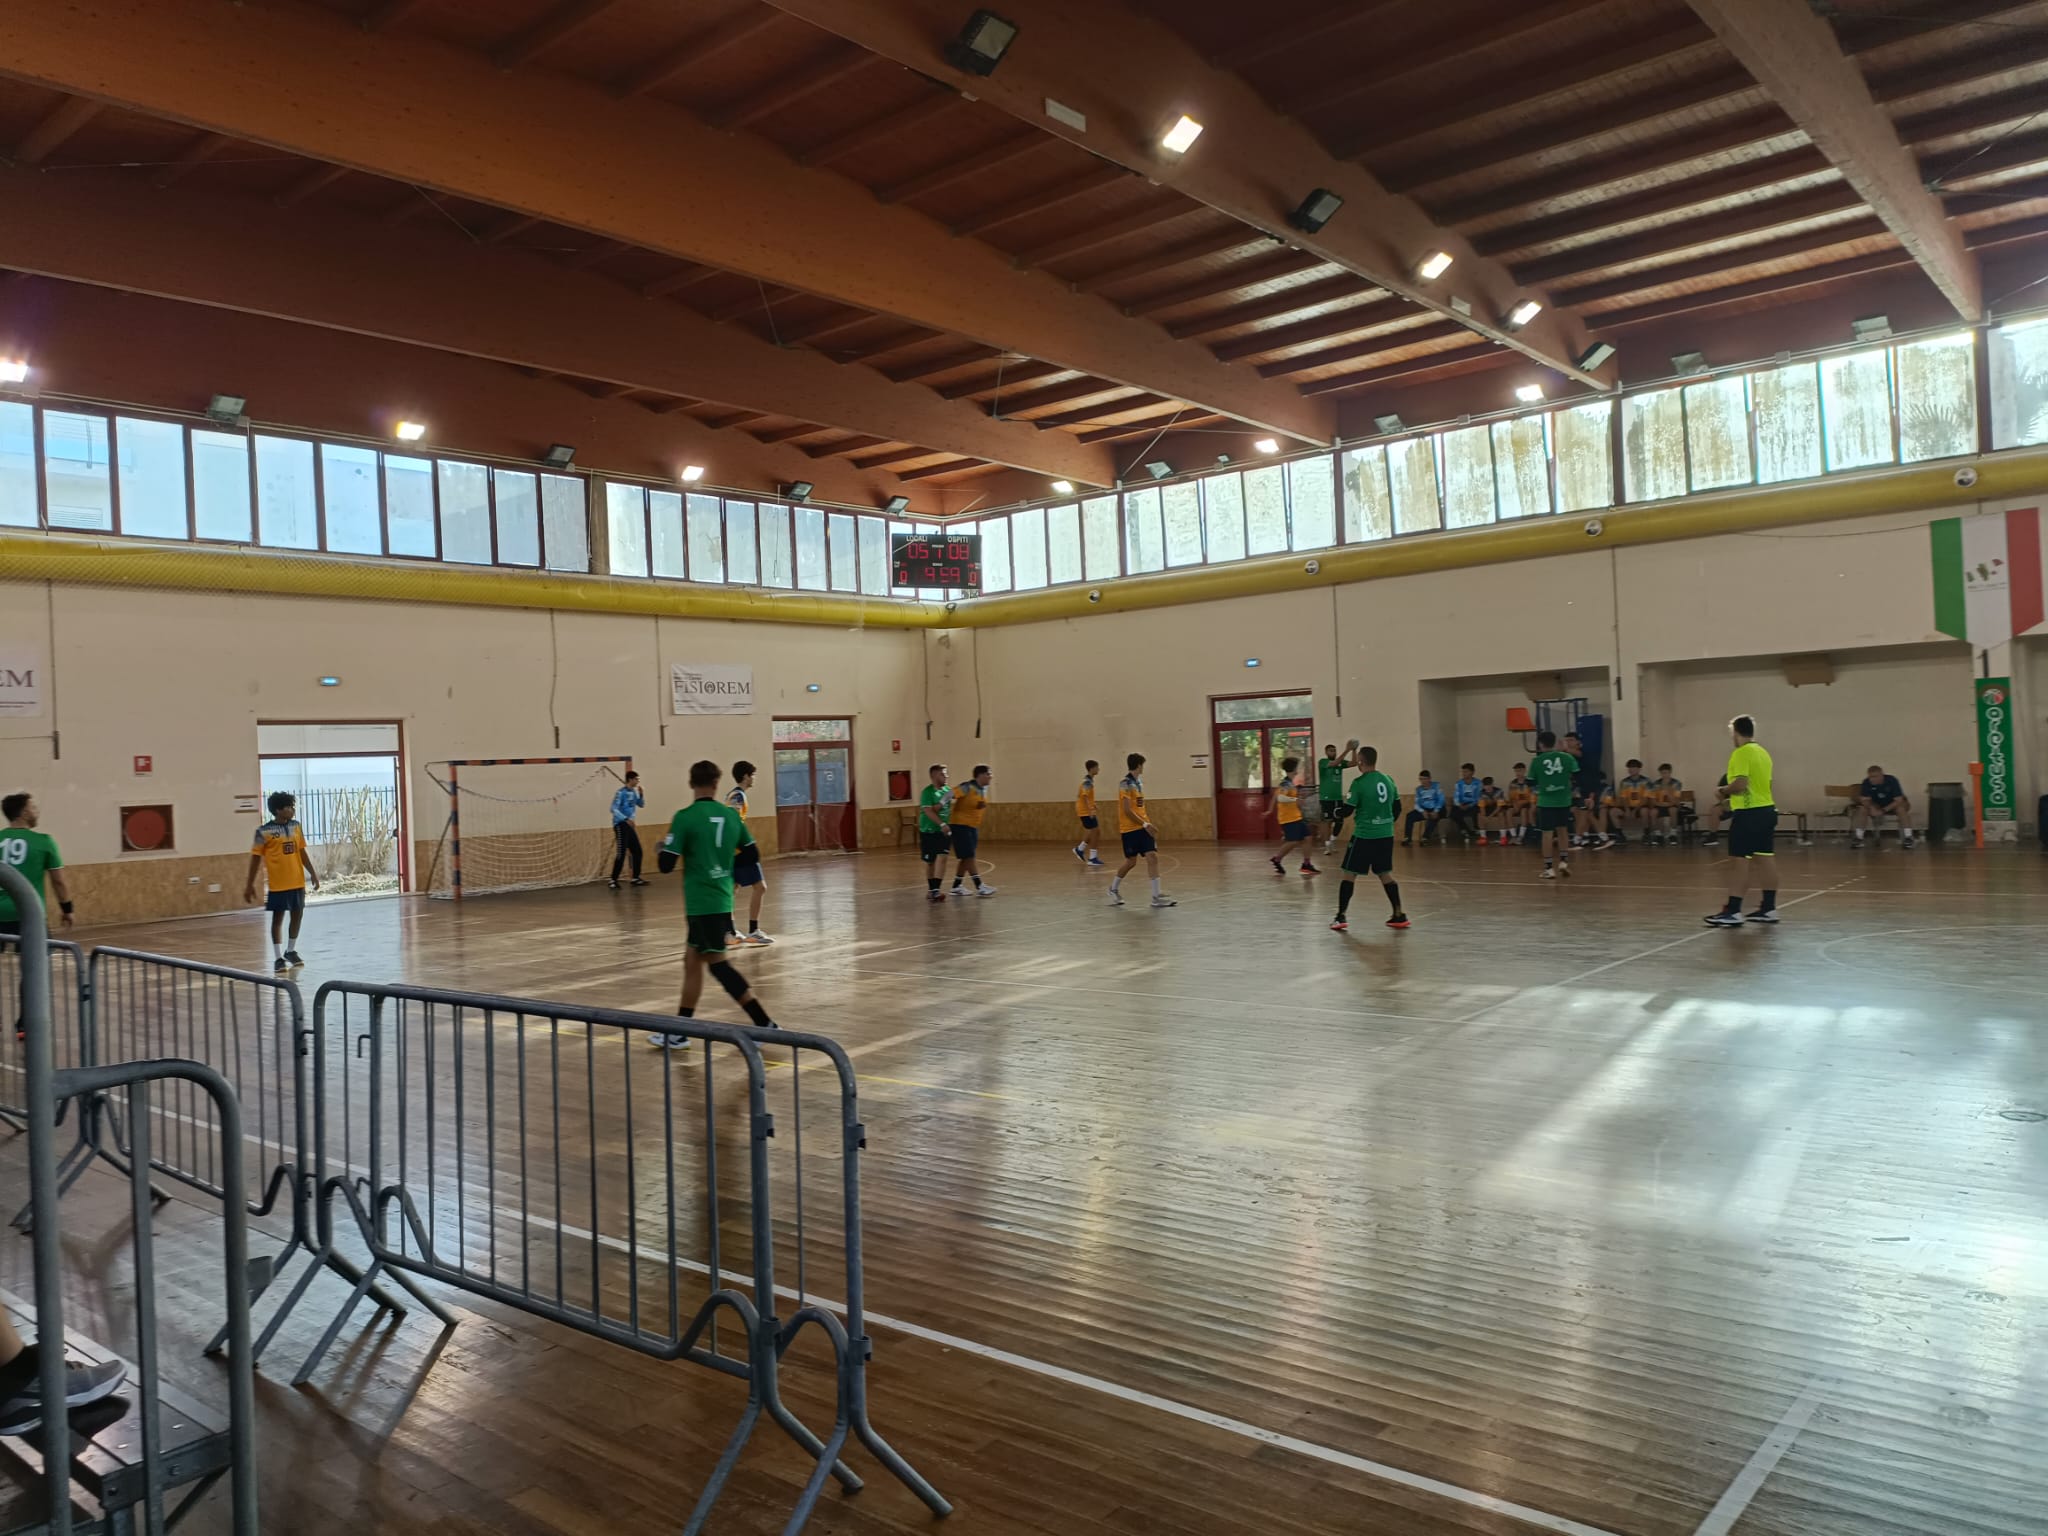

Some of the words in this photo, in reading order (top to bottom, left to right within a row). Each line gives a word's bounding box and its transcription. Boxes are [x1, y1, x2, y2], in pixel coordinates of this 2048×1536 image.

[1543, 757, 1563, 776] 34
[1377, 782, 1388, 803] 9
[709, 816, 725, 848] 7
[0, 838, 28, 865] 19
